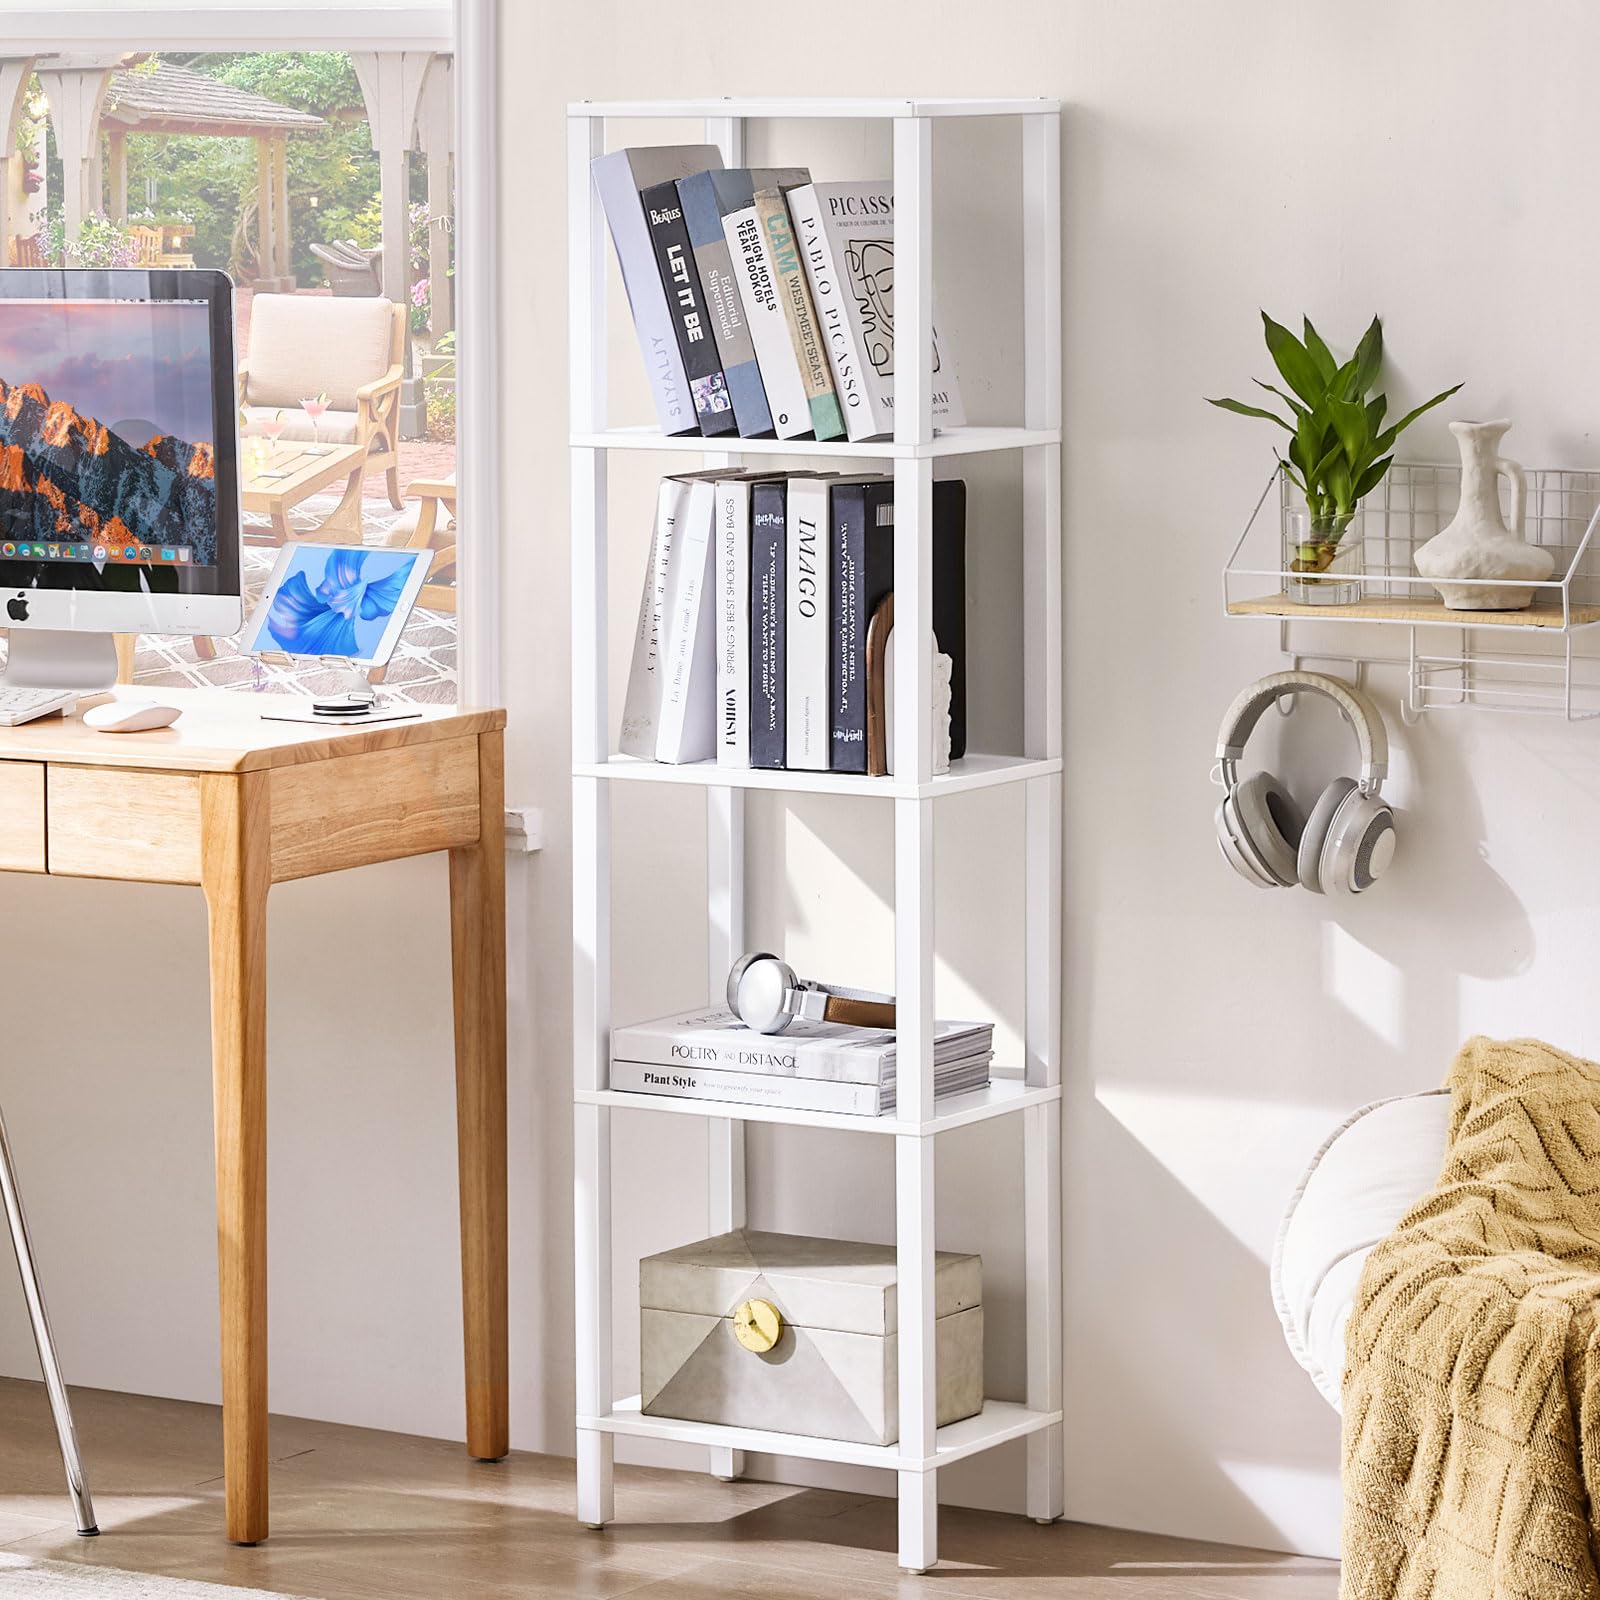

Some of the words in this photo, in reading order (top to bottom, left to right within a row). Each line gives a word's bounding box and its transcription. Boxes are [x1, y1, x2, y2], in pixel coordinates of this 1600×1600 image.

[828, 195, 894, 216] PICASS
[736, 222, 751, 253] YEAR
[666, 244, 690, 283] LET
[745, 219, 764, 262] DESIGN
[758, 265, 777, 311] HOTELS
[677, 287, 696, 308] IT
[708, 270, 735, 340] Supermodel
[720, 275, 742, 328] Editorial
[767, 213, 799, 275] CAM
[789, 275, 826, 388] WESTMEETSEAST
[802, 218, 831, 295] PABLO
[825, 308, 861, 408] PICASSO
[683, 311, 704, 343] BE
[725, 498, 735, 528] BAGS
[726, 531, 735, 557] AND
[726, 559, 735, 596] SHOES
[798, 516, 817, 618] IMAGO
[841, 560, 848, 578] AN
[726, 599, 735, 622] BEST
[849, 593, 855, 606] TO
[726, 625, 736, 675] SPRING'S
[762, 648, 769, 661] TO
[770, 676, 776, 694] AN
[725, 689, 736, 746] FASHION
[671, 1045, 720, 1061] POETRY
[739, 1051, 800, 1069] DISTANCE
[644, 1073, 670, 1085] Plant
[672, 1075, 697, 1089] Style
